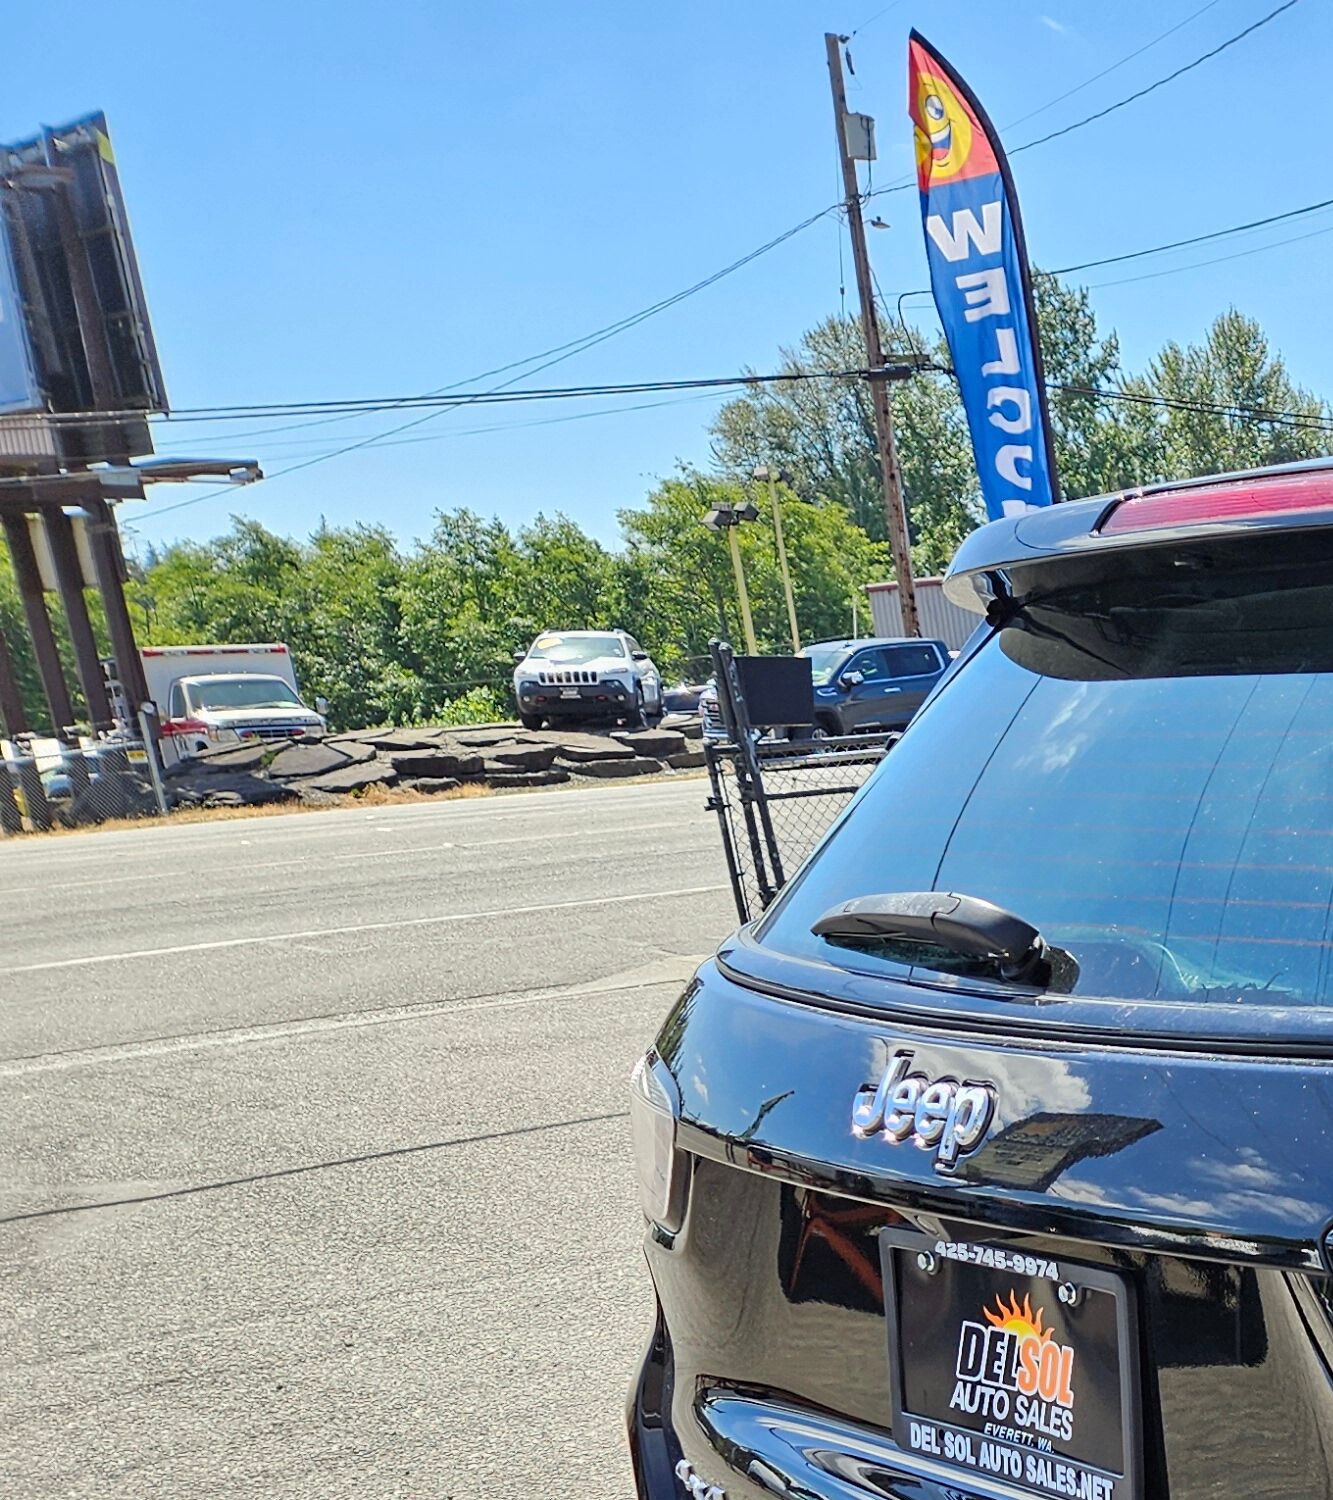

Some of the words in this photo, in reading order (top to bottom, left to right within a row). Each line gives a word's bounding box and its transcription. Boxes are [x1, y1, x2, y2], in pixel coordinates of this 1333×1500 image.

[852, 1049, 999, 1174] Jeep
[934, 1240, 1060, 1281] 425-745-9974
[950, 1381, 1009, 1420] AUTO
[1014, 1394, 1074, 1441] SALES
[910, 1421, 940, 1455] DEL
[943, 1430, 976, 1466] SOL
[979, 1440, 1023, 1479] AUTO
